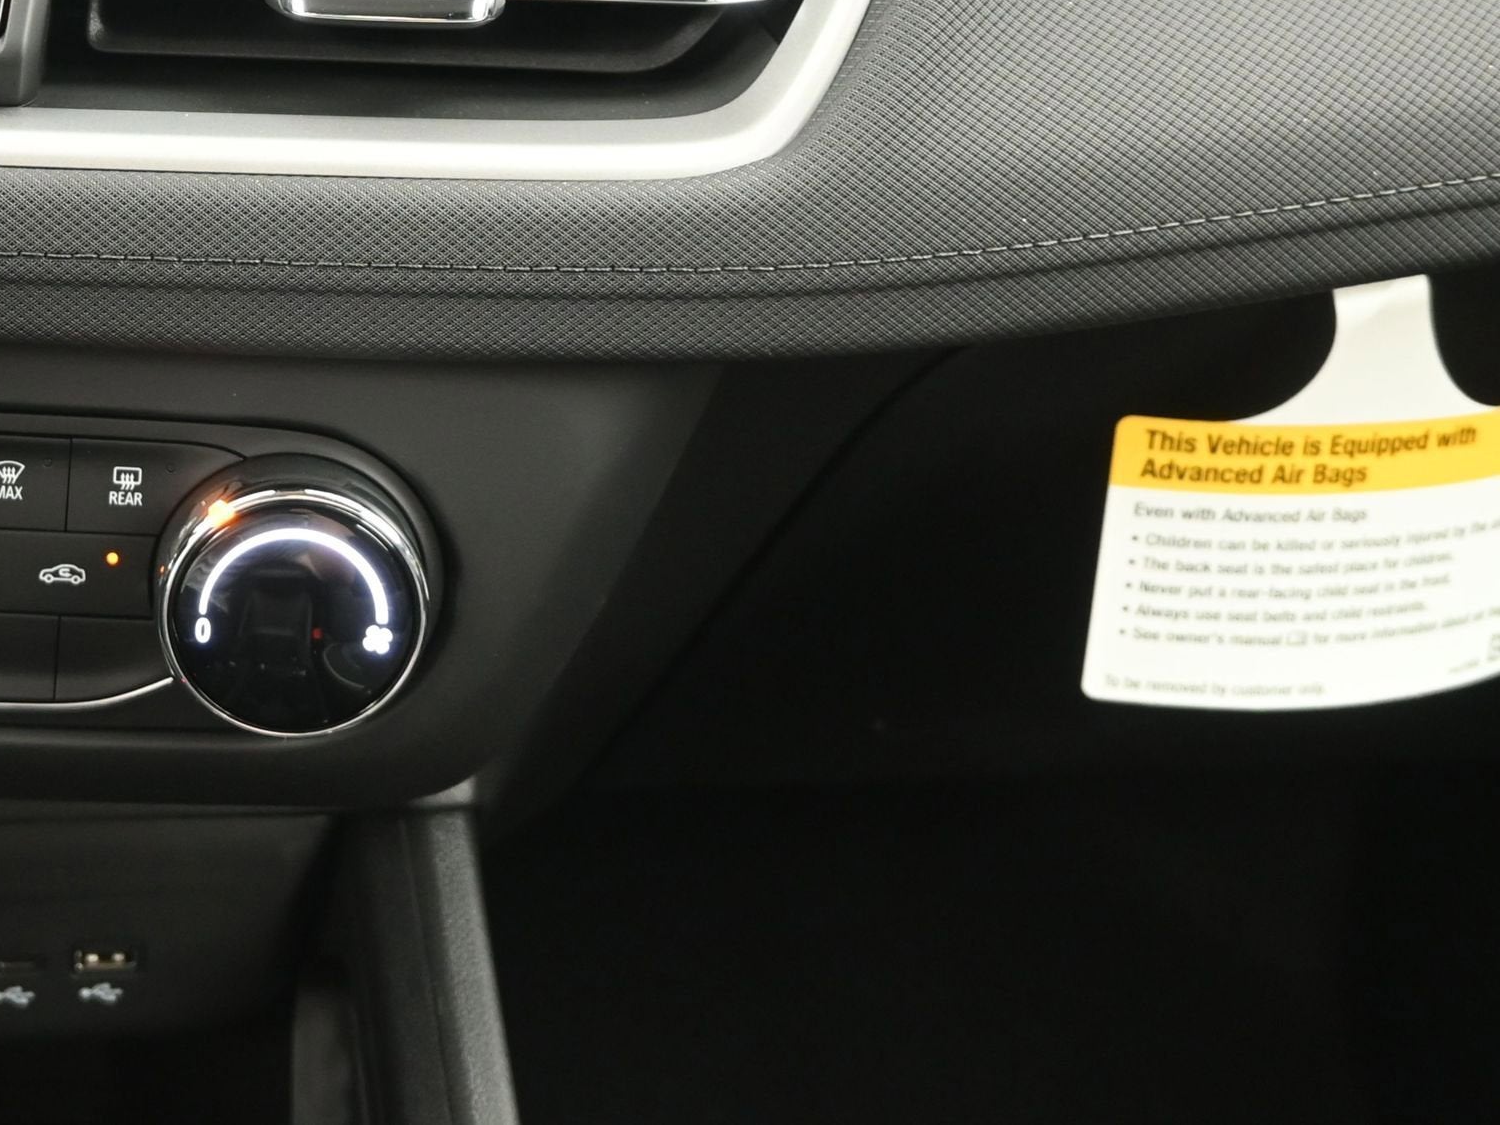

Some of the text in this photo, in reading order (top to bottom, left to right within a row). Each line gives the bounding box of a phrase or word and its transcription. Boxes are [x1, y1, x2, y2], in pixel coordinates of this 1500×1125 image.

[1146, 426, 1477, 458] This Vehicle is Equipped with
[1140, 458, 1368, 488] Advanced Air Bags
[108, 490, 143, 507] REAR
[1133, 502, 1368, 524] Even with Advanced Air Bags
[1145, 532, 1212, 549] Children
[1218, 539, 1246, 551] can
[1251, 538, 1269, 551] be
[1144, 556, 1169, 572] The
[1175, 559, 1211, 574] back
[1139, 580, 1181, 596] Never
[1135, 603, 1189, 621] Always
